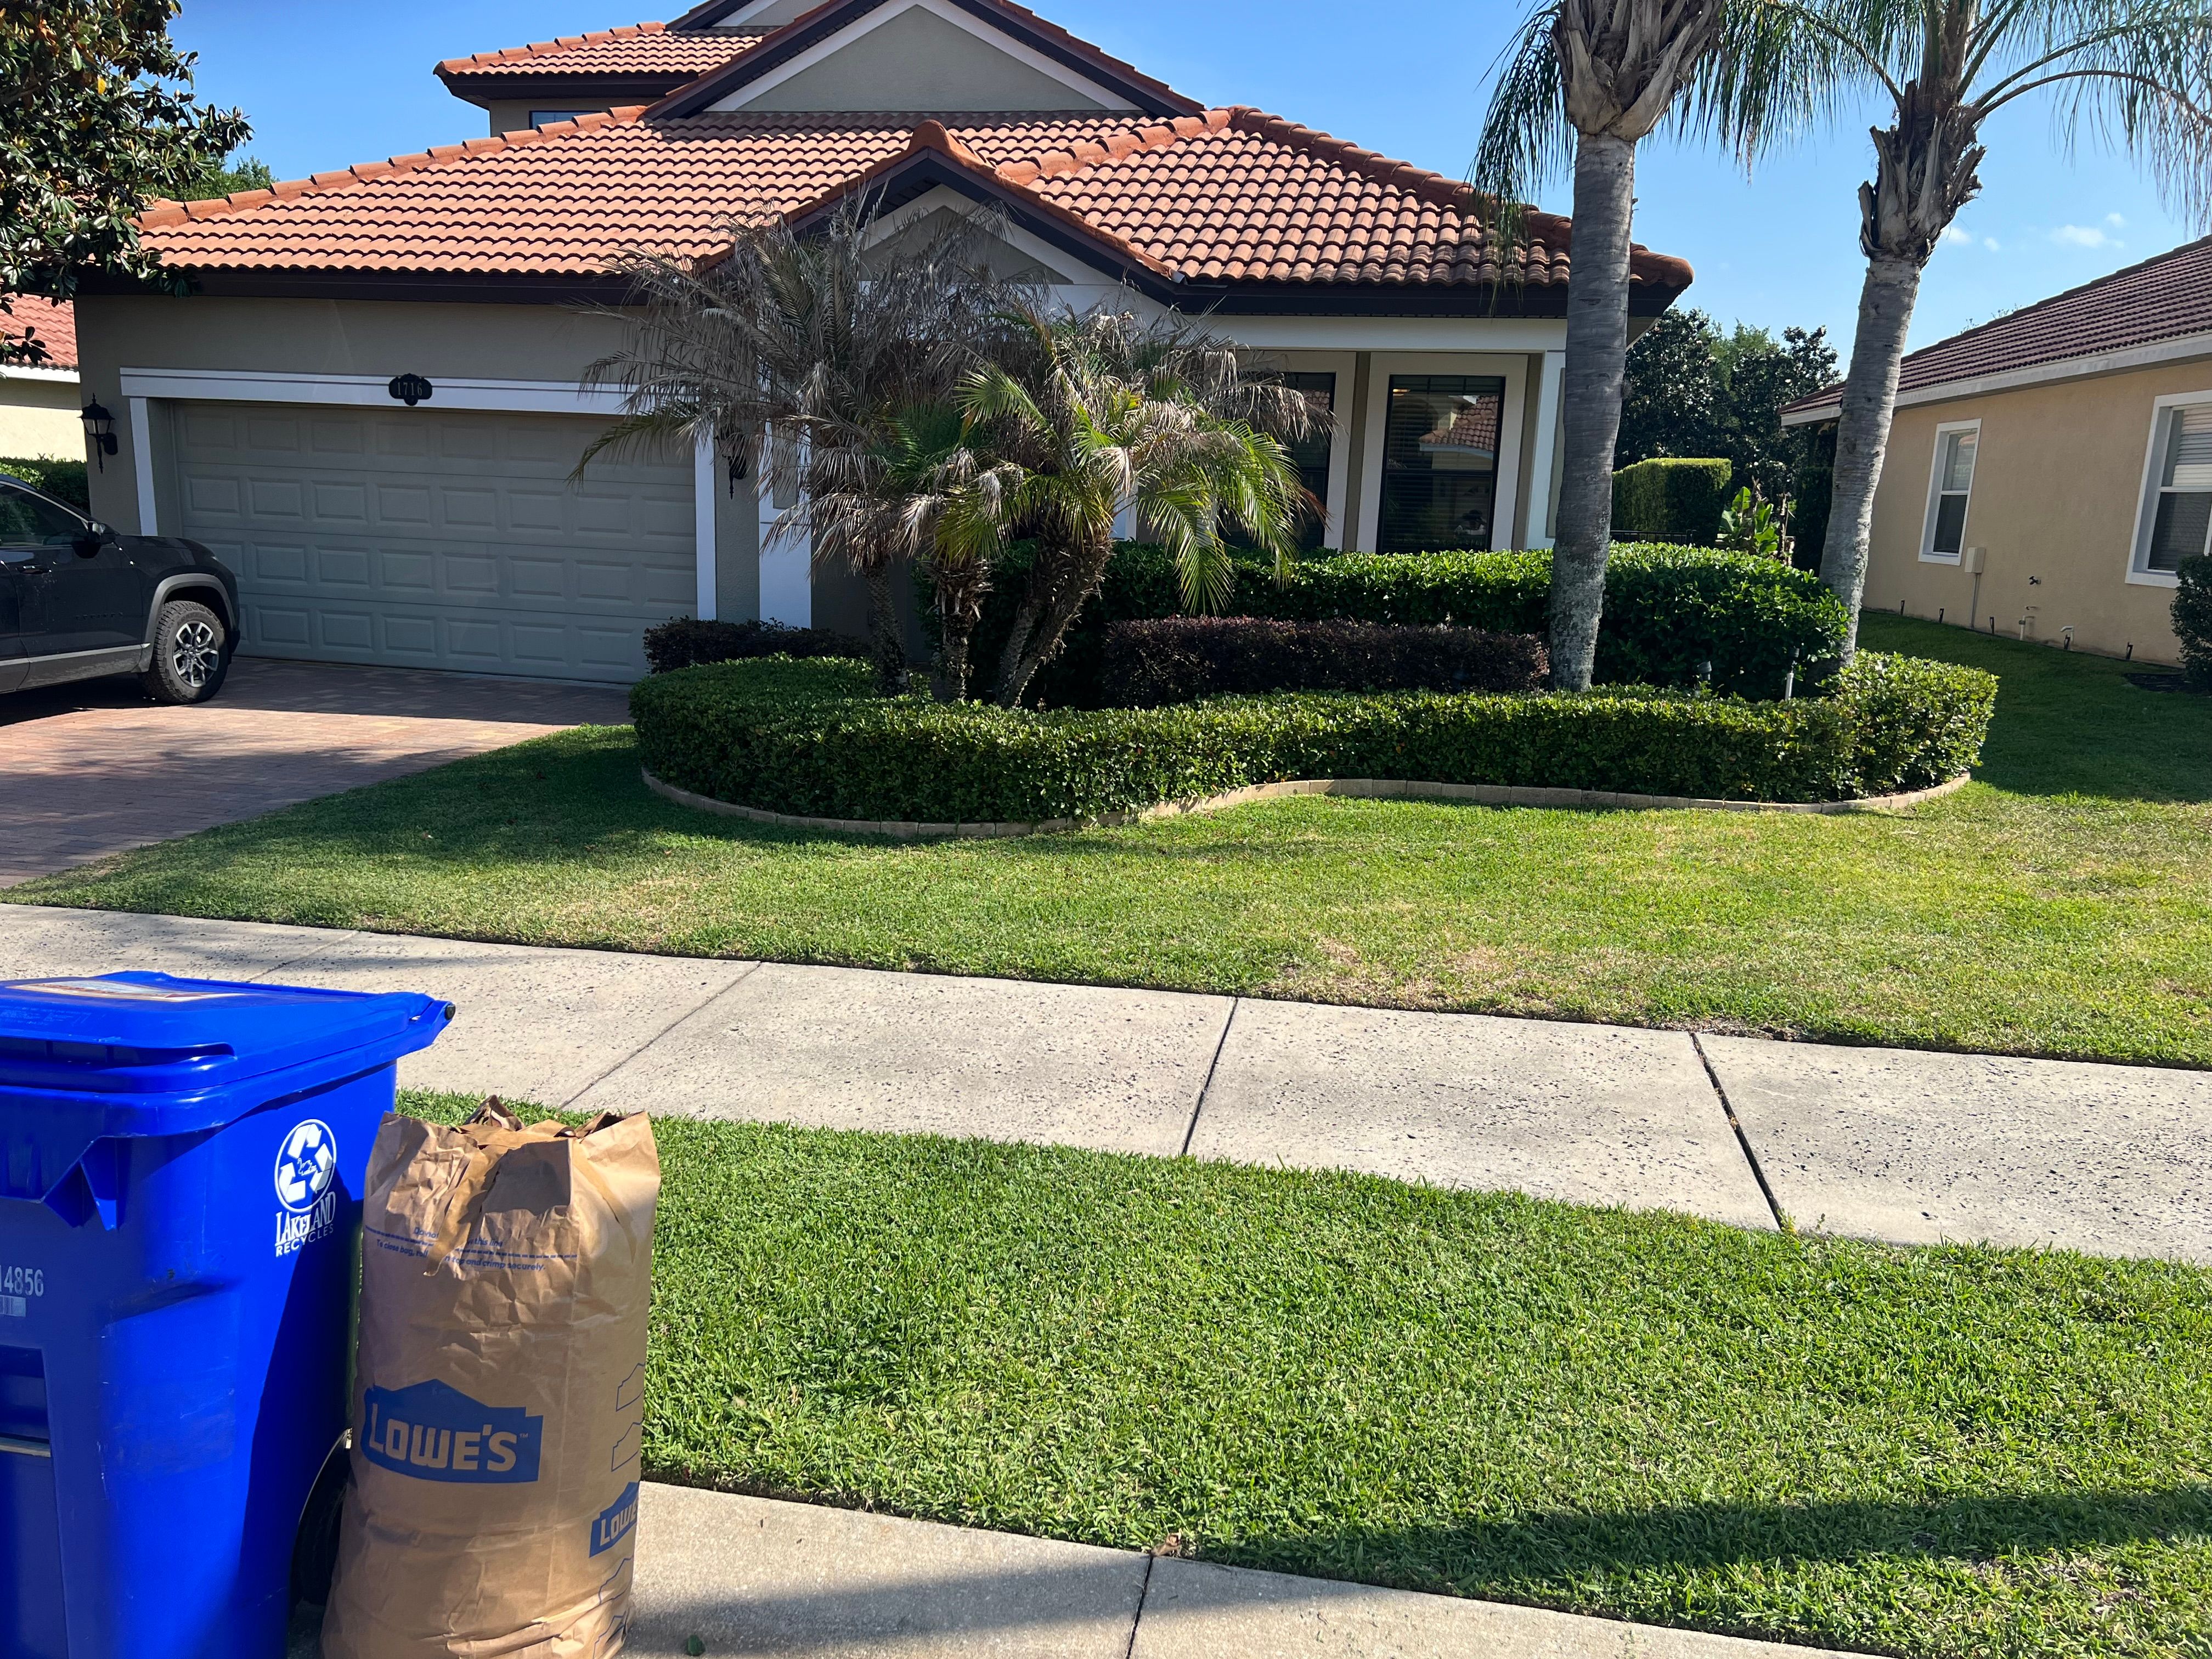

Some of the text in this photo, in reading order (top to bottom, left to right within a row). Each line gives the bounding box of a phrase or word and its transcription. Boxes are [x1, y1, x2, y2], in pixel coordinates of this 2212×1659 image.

[397, 382, 422, 396] 1716
[275, 1191, 336, 1246] LAKELAND
[275, 1223, 334, 1257] RECYCLES
[377, 1239, 383, 1248] To
[384, 1242, 399, 1251] close
[400, 1245, 414, 1257] bag,
[416, 1249, 428, 1258] roll
[466, 1257, 482, 1266] and
[483, 1260, 505, 1269] crimp
[507, 1262, 546, 1271] securely.
[474, 1237, 488, 1245] this
[0, 1265, 44, 1296] 4856
[369, 1403, 517, 1472] LOWE'S
[600, 1497, 637, 1547] LOWE
